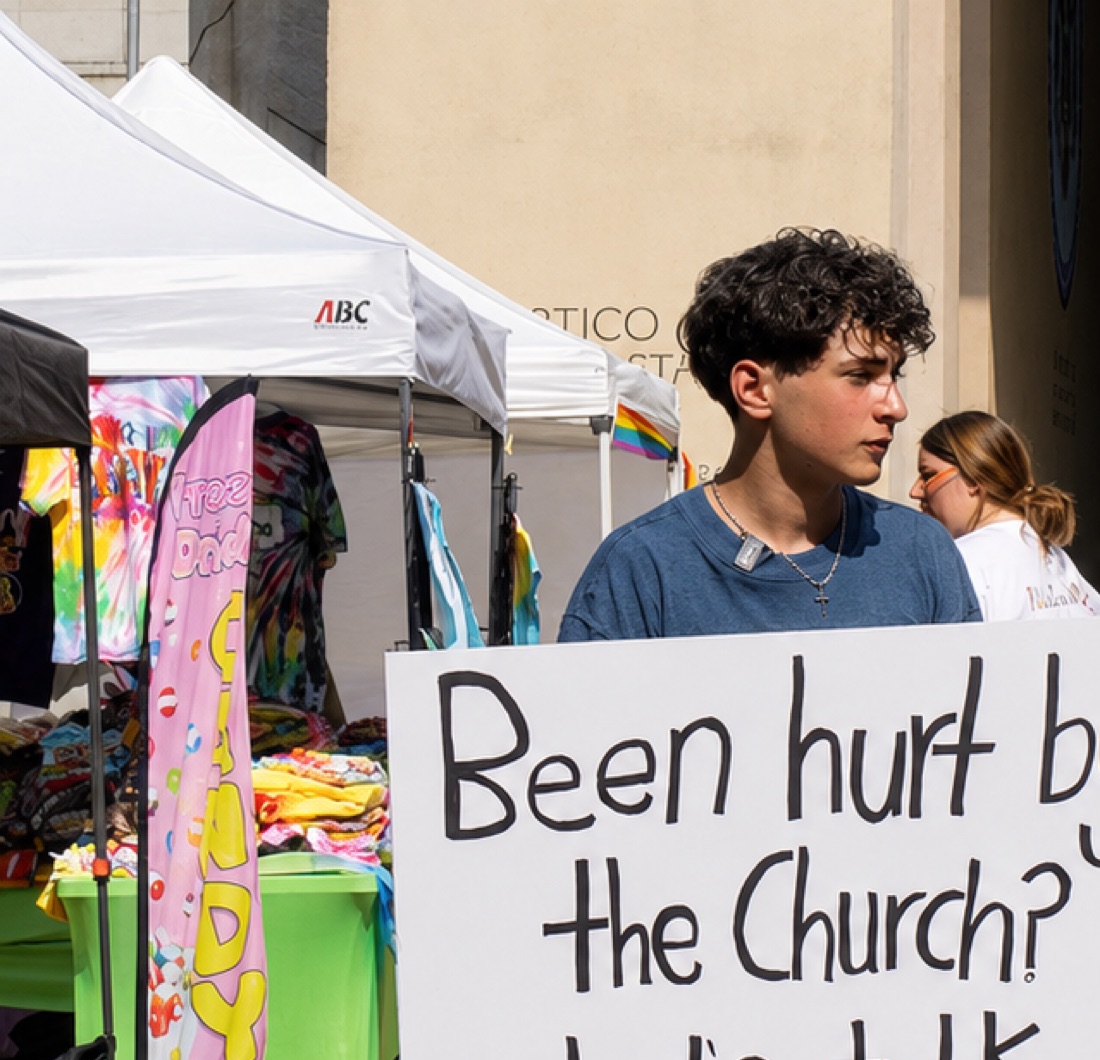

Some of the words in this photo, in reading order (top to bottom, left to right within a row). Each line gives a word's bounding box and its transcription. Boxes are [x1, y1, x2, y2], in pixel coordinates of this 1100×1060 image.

[314, 299, 370, 324] ABC
[531, 306, 658, 341] TICO
[437, 670, 732, 841] Been
[787, 655, 996, 824] hurt
[542, 858, 703, 994] the
[732, 846, 1072, 986] Church?
